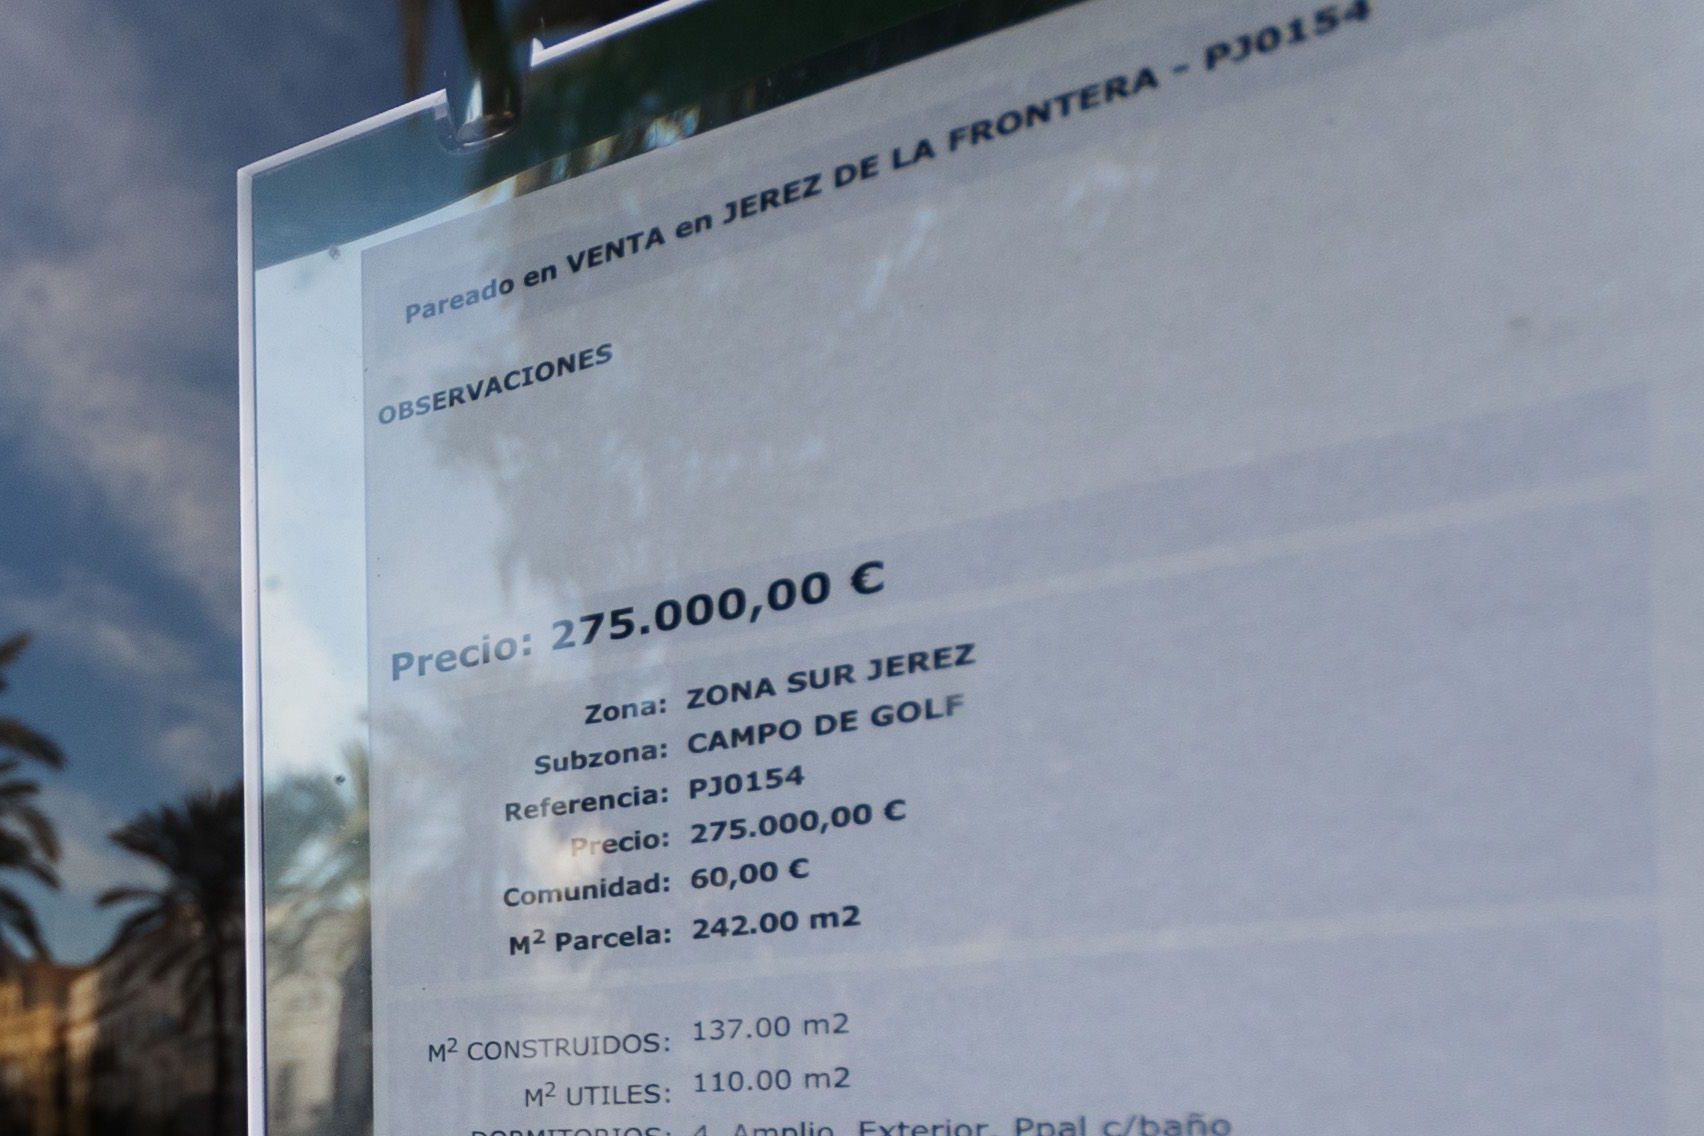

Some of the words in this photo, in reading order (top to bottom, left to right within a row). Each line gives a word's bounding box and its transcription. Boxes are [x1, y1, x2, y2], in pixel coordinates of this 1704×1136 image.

[405, 277, 516, 325] Pareado
[523, 264, 558, 288] en
[566, 226, 666, 274] VENTA
[674, 214, 713, 239] en
[722, 173, 822, 225] JEREZ
[833, 154, 879, 189] DE
[891, 138, 936, 171] LA
[948, 67, 1159, 153] FRONTERA
[1204, 0, 1371, 71] PJ0154
[377, 343, 612, 425] OBSERVACIONES
[391, 633, 531, 682] Precio:
[551, 571, 831, 649] 275.000,00
[850, 560, 884, 596] €
[584, 698, 666, 725] Zona:
[686, 677, 777, 710] ZONA
[787, 663, 856, 694] SUR
[866, 643, 975, 682] JEREZ
[534, 743, 668, 775] Subzona:
[687, 718, 802, 754] CAMPO
[814, 709, 858, 737] DE
[870, 694, 962, 728] GOLF
[505, 785, 668, 822] Referencia:
[689, 765, 805, 800] PJ0154
[570, 829, 670, 858] Precio:
[690, 803, 873, 845] 275.000,00
[883, 798, 906, 822] €
[503, 872, 670, 908] Comunidad:
[690, 861, 779, 891] 60,00
[788, 857, 809, 880] €
[555, 924, 671, 953] Parcela:
[692, 910, 799, 940] 242.00
[809, 904, 861, 930] m2
[466, 1032, 670, 1062] CONSTRUIDOS:
[693, 1015, 791, 1042] 137.00
[803, 1012, 850, 1036] m2
[566, 1082, 671, 1107] UTILES:
[694, 1068, 792, 1093] 110.00
[804, 1066, 851, 1089] m2
